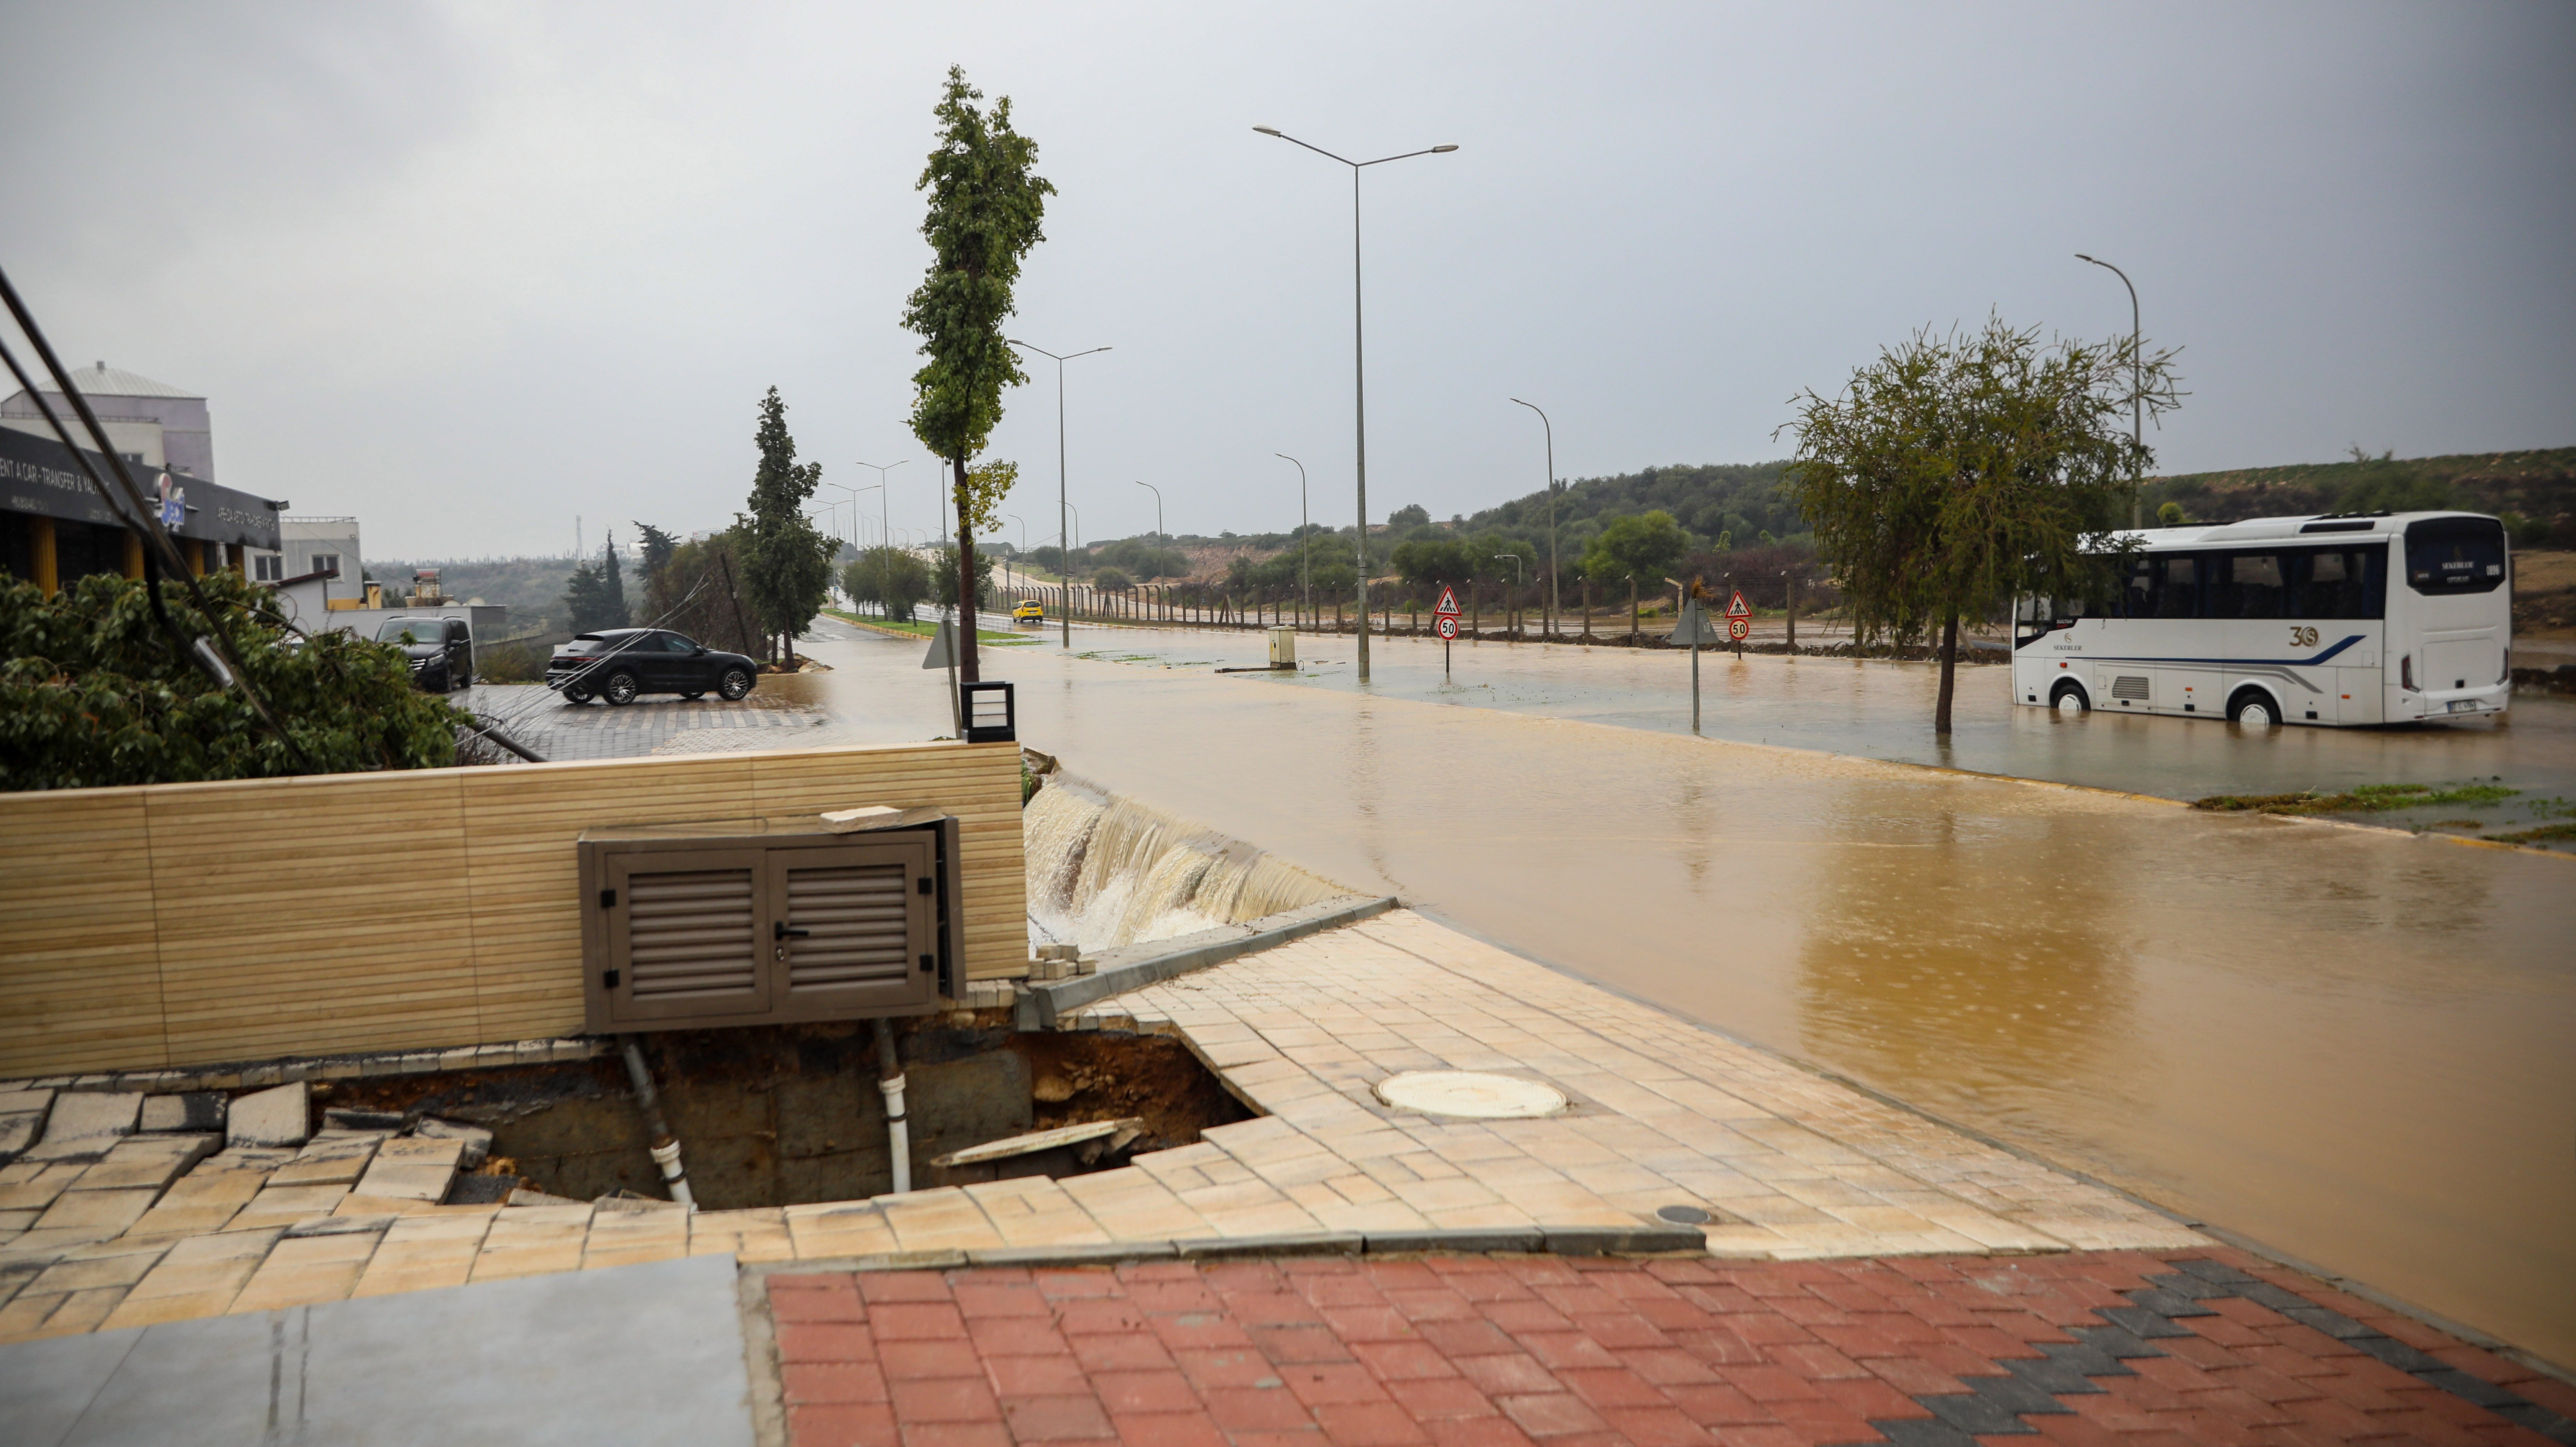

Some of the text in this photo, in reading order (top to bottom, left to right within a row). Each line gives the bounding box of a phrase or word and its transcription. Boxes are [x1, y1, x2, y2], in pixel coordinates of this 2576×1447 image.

[0, 458, 13, 478] ENT
[17, 462, 21, 479] A
[23, 463, 38, 483] CAR
[42, 468, 75, 490] TRANSFER
[78, 475, 82, 492] &
[2486, 565, 2499, 576] 0896
[1442, 623, 1454, 634] 50
[1733, 624, 1745, 634] 50
